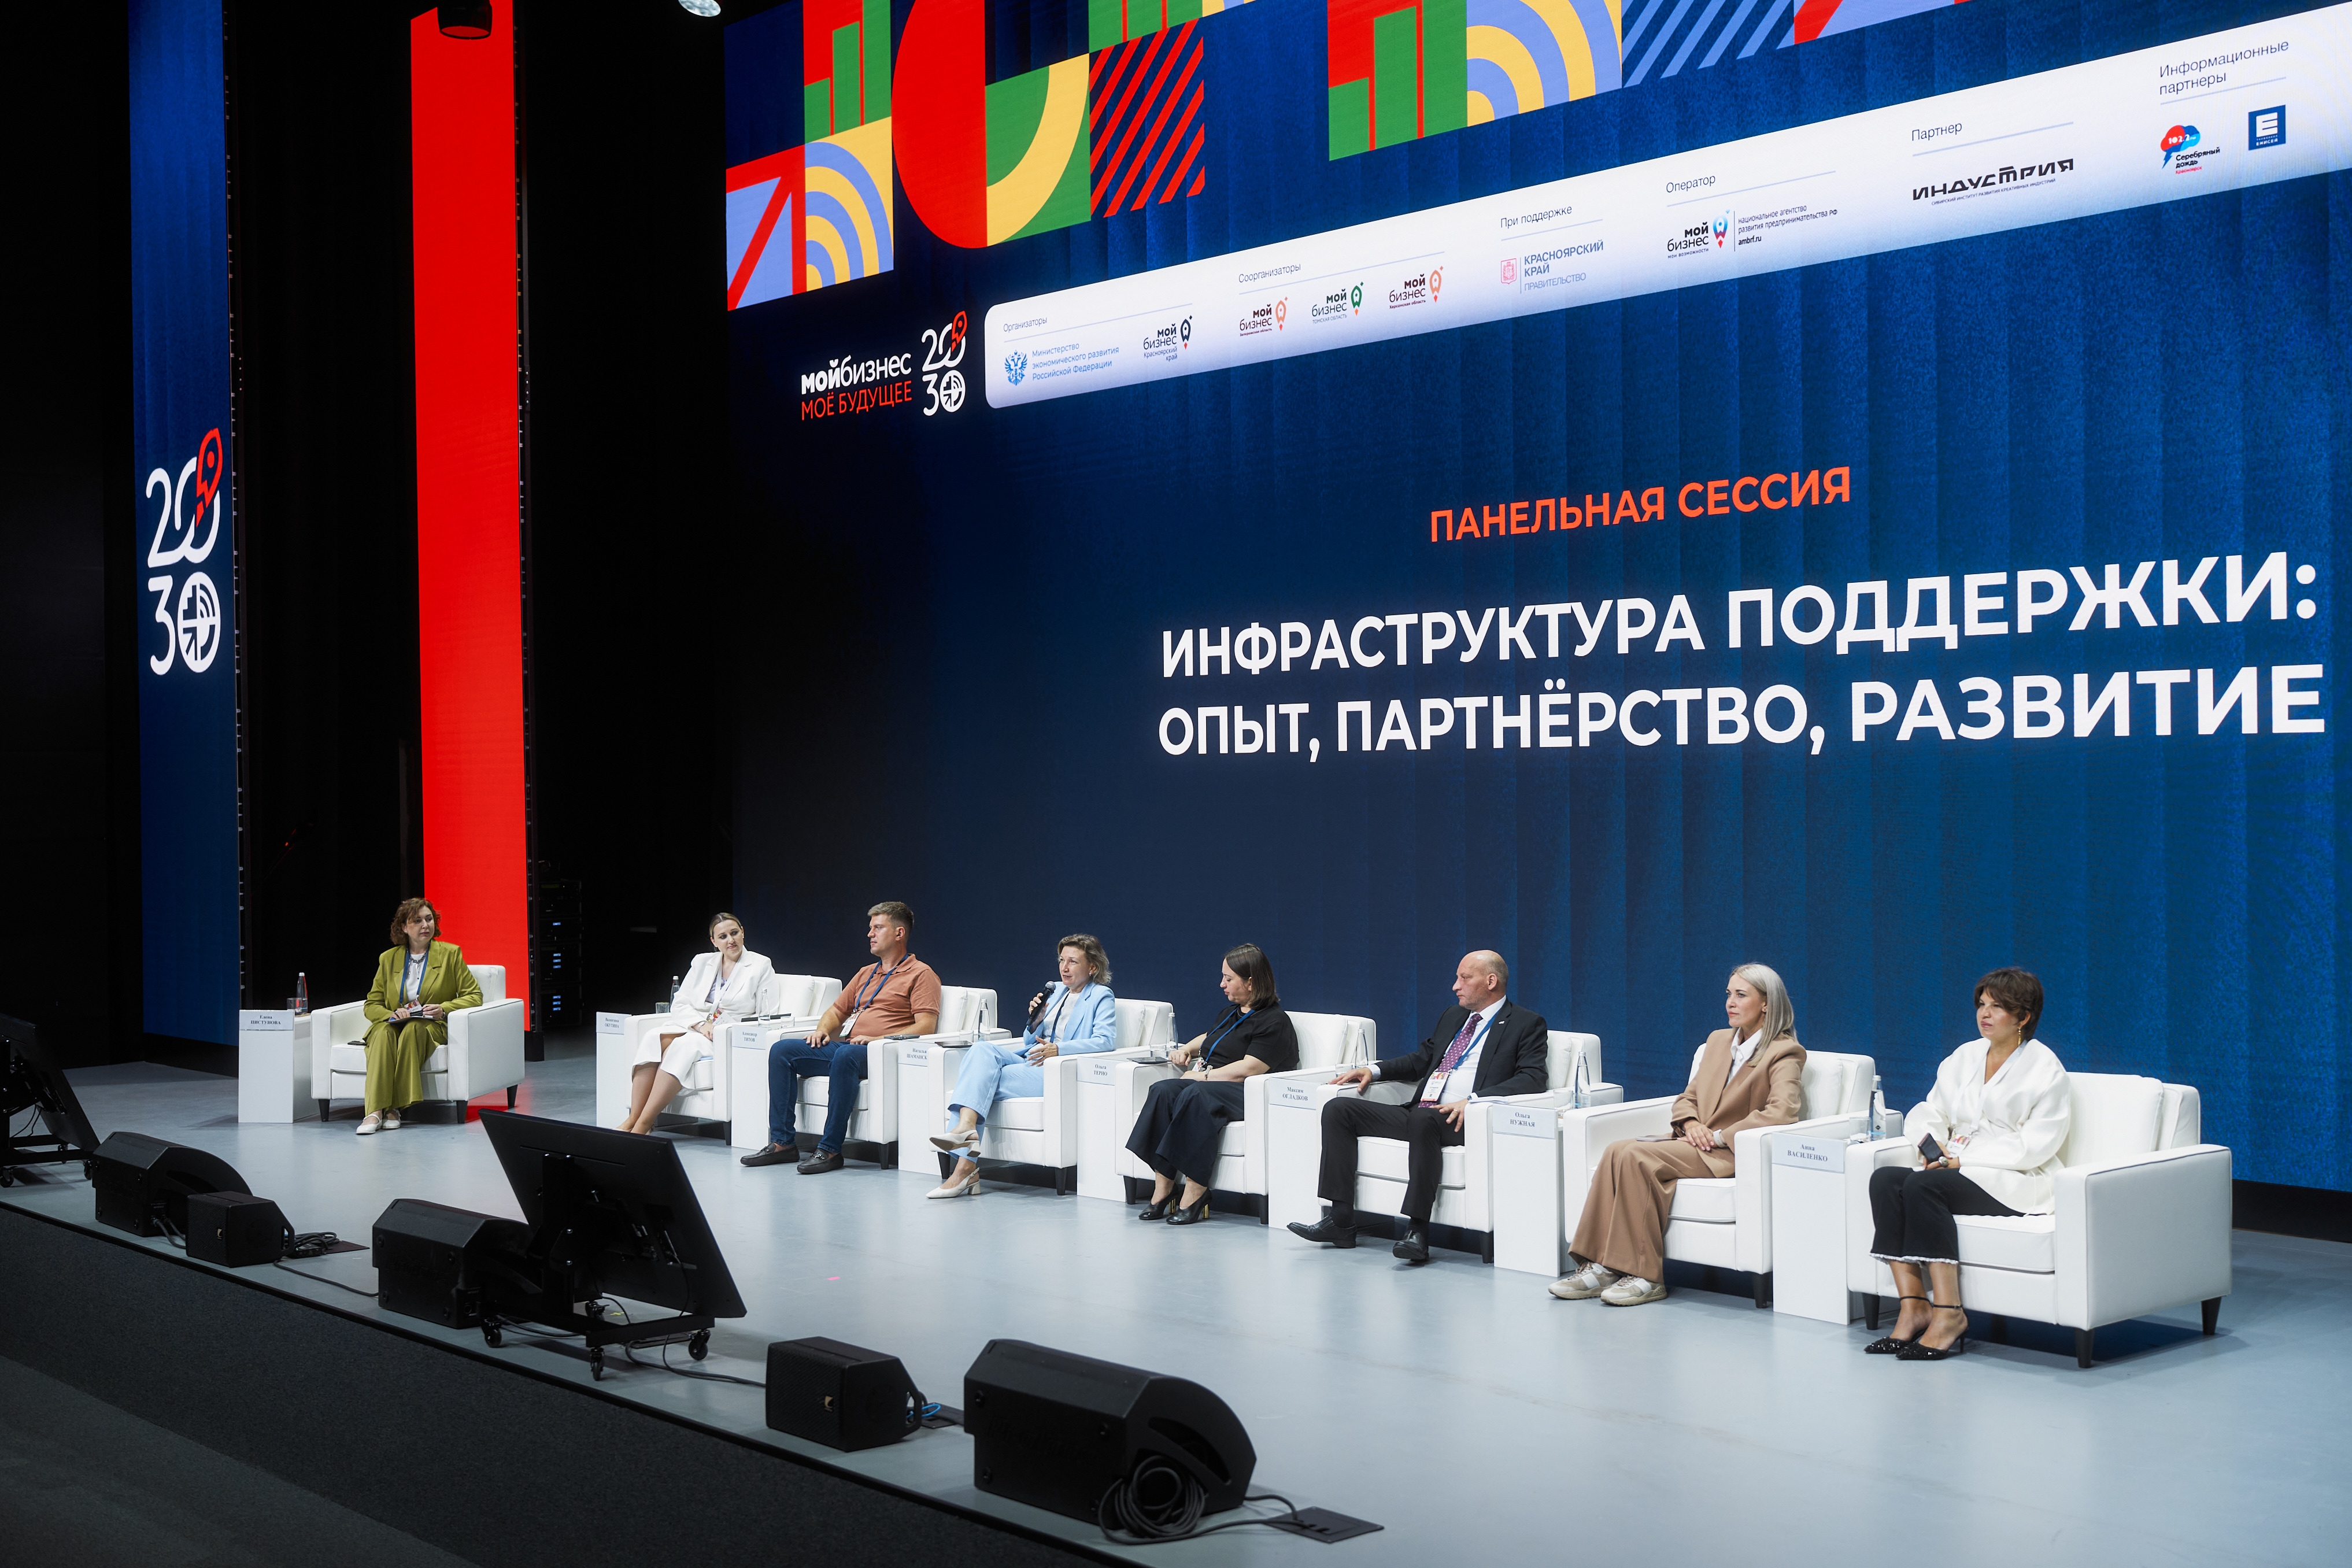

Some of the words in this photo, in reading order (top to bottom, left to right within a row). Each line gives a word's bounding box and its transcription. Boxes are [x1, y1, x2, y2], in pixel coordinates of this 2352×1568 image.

[2159, 39, 2289, 79] Информационные
[2159, 72, 2227, 95] партнеры
[1911, 121, 1962, 142] Партнер
[2168, 134, 2190, 144] 102.2
[2176, 146, 2220, 161] Серебряный
[2176, 160, 2198, 169] дождь
[1666, 174, 1716, 195] Оператор
[1913, 158, 2074, 201] ИНДУСТРИЯ
[1932, 197, 1956, 205] СИБИРСКИЙ
[1979, 189, 2000, 197] РАЗВИТИЯ
[2001, 184, 2029, 193] КРЕАТИВНЫХ
[2029, 177, 2055, 187] ИНДУСТРИЙ
[1501, 217, 1518, 229] При
[1521, 206, 1572, 224] поддержке
[1738, 210, 1778, 224] национальное
[1780, 205, 1807, 217] агентство
[1685, 221, 1708, 238] мой
[1738, 223, 1763, 235] развития
[1765, 211, 1828, 229] предпринимательства
[1667, 236, 1709, 252] бизнес
[1738, 235, 1762, 246] ambrf.ru
[1524, 239, 1604, 265] КРАСНОЯРСКИЙ
[1238, 262, 1301, 283] Соорганизаторы
[1524, 262, 1549, 277] КРАЙ
[1404, 273, 1425, 289] мой
[1524, 272, 1586, 291] ПРАВИТЕЛЬСТВО
[1326, 289, 1347, 304] мой
[1389, 288, 1426, 302] бизнес
[1253, 304, 1272, 318] мой
[1312, 302, 1347, 317] бизнес
[1003, 316, 1048, 332] Организаторы
[1157, 323, 1177, 338] мой
[1240, 317, 1272, 331] бизнес
[1032, 343, 1079, 358] Министерство
[1143, 336, 1177, 350] бизнес
[1032, 353, 1086, 369] экономического
[1088, 347, 1119, 360] развития
[1144, 346, 1177, 359] Красноярский
[1166, 353, 1178, 362] край
[1033, 367, 1071, 381] Российской
[1073, 360, 1112, 374] Федерации
[801, 392, 835, 420] МОЁ
[839, 380, 912, 413] БУДУЩЕЕ
[1430, 486, 1665, 542] ПАНЕЛЬНАЯ
[1678, 466, 1850, 517] СЕССИЯ
[1162, 594, 1705, 678] ИНФРАСТРУКТУРА
[1728, 551, 2317, 655] ПОДДЕРЖКИ:
[1157, 702, 1321, 763] ОПЫТ,
[1337, 678, 1826, 755] ПАРТНЁРСТВО,
[1851, 664, 2325, 742] РАЗВИТИЕ
[1510, 1119, 1535, 1127] НУЖНАЯ
[1515, 1111, 1530, 1119] Ольга
[1787, 1150, 1828, 1162] ВАСИЛЕНКО
